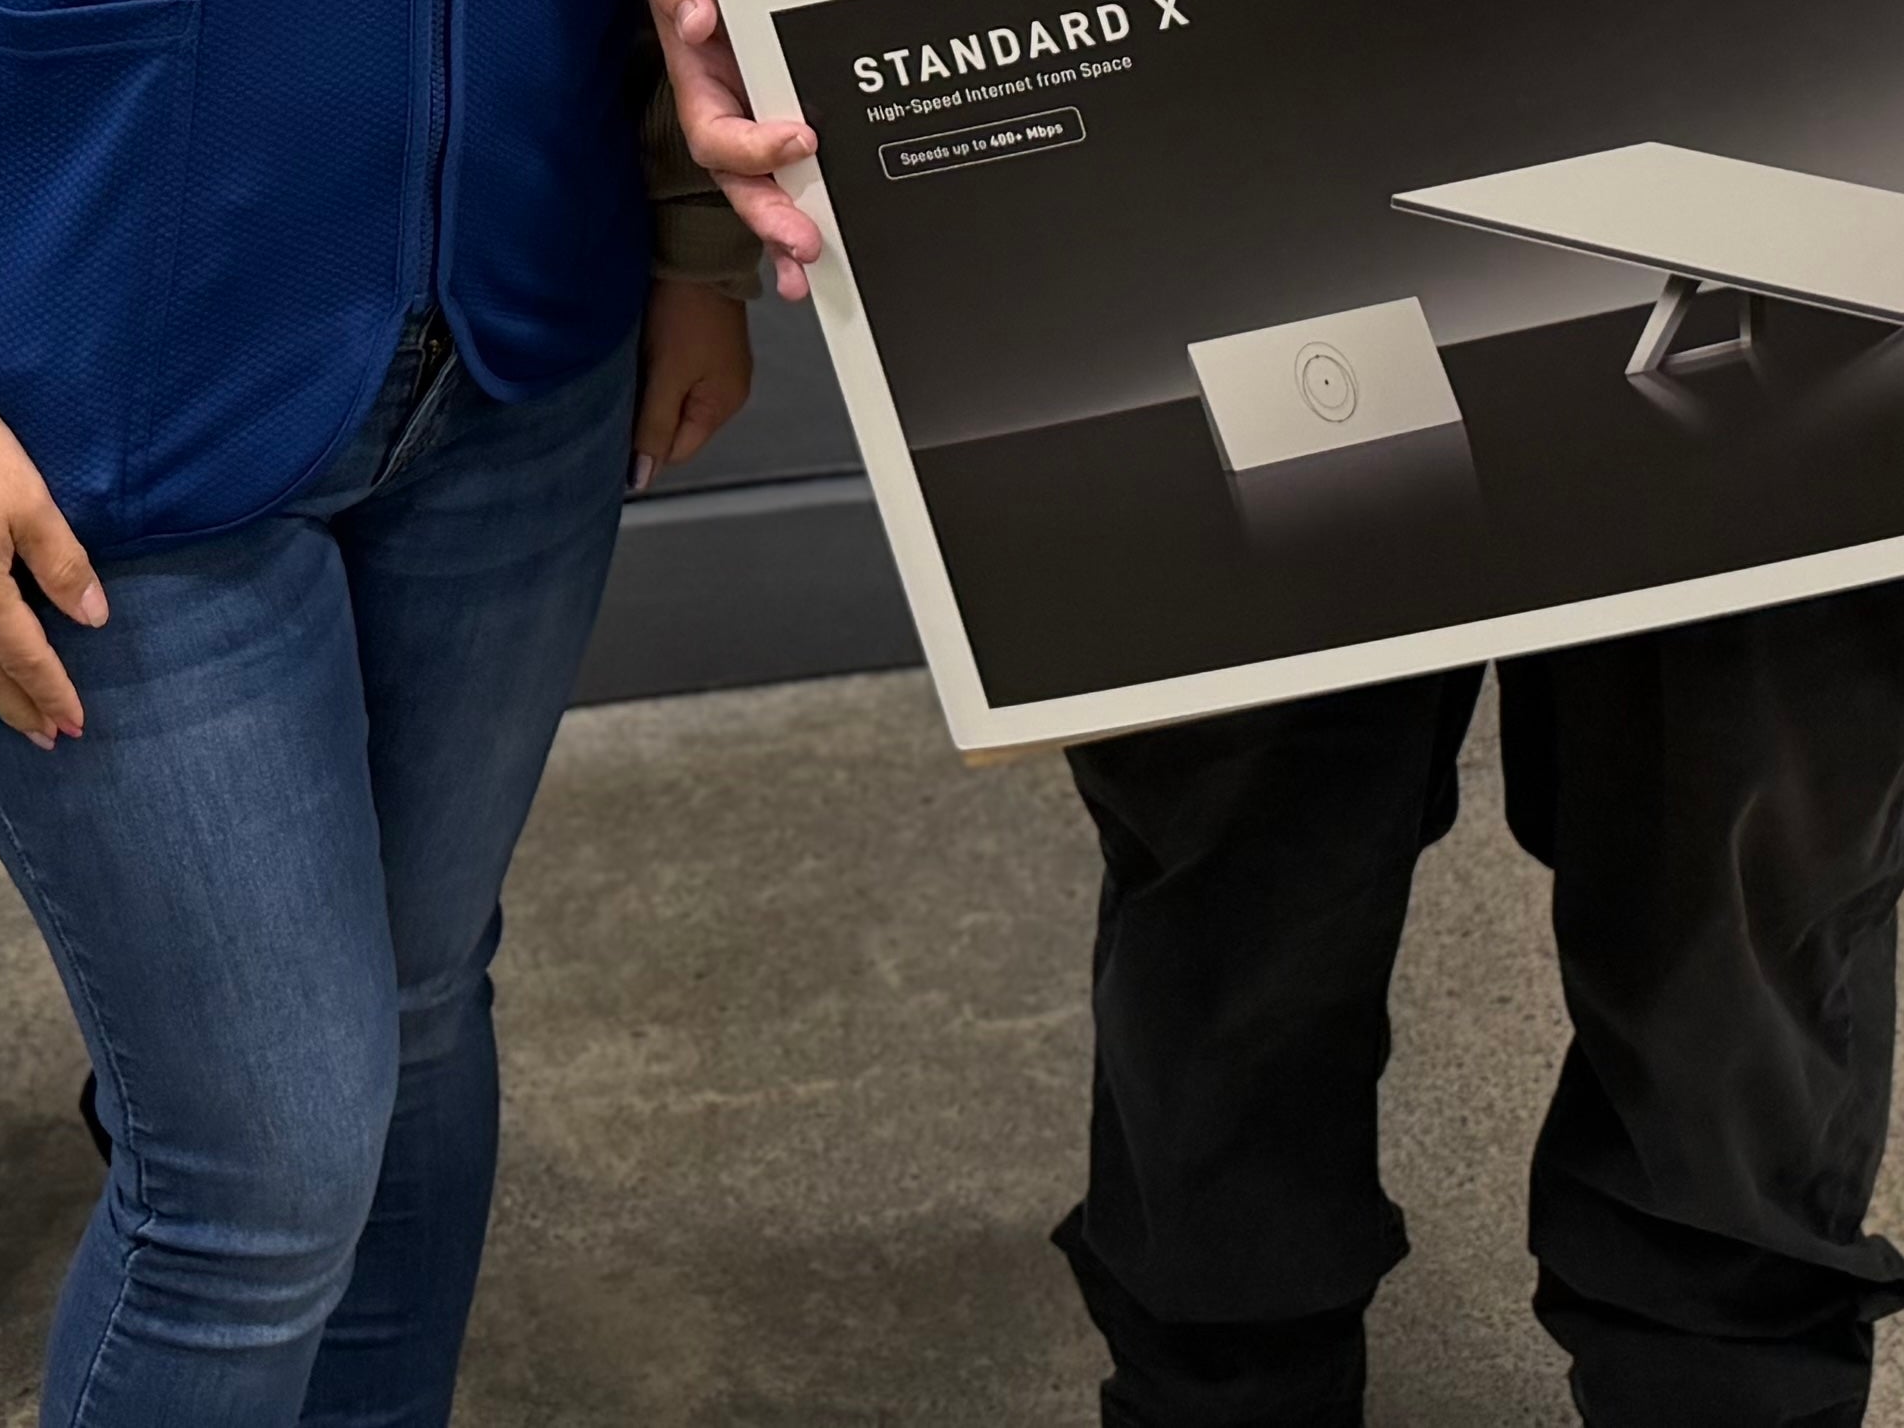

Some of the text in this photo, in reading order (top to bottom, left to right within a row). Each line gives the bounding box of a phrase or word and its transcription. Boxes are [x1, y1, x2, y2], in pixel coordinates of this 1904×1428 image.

[853, 3, 1131, 94] STANDARD
[866, 55, 1133, 123] High-Speed Internet from Space
[900, 122, 1064, 167] Speeds up to 400+ Mbps
